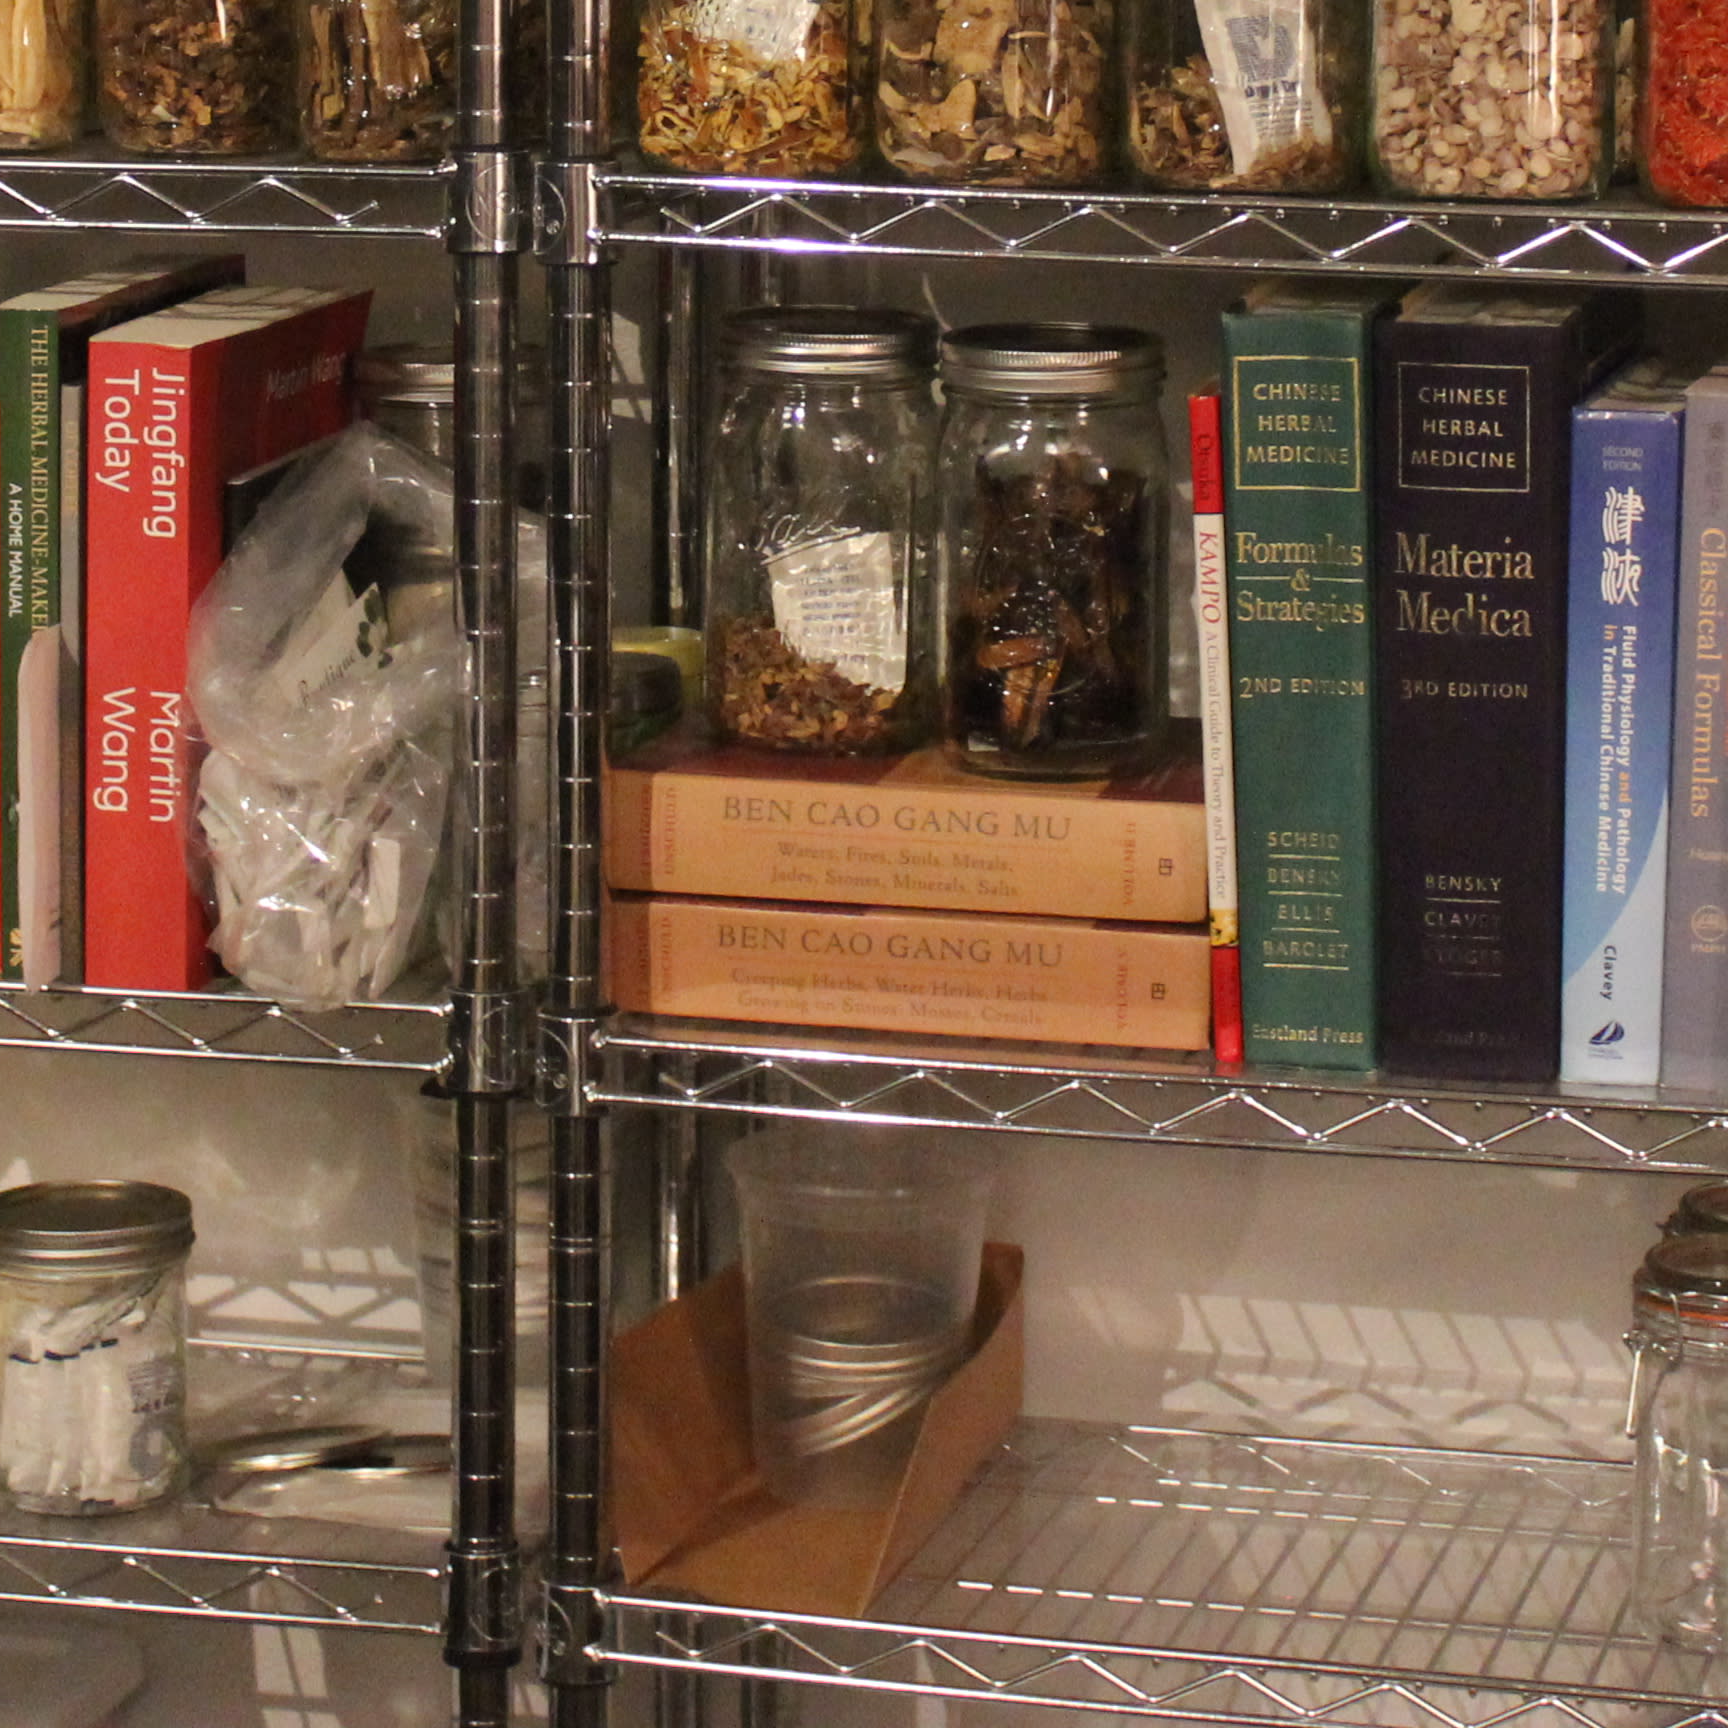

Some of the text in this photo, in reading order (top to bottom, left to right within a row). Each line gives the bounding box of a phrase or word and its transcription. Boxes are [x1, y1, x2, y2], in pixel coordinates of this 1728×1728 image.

[30, 325, 50, 449] THE HERBAL
[1252, 383, 1342, 402] CHINESE
[1418, 386, 1509, 406] CHINESE
[94, 368, 141, 493] Today
[1257, 414, 1337, 433] HERBAL
[1422, 419, 1505, 438] HERBAL
[142, 367, 186, 539] Jingfang
[1246, 445, 1350, 465] MEDICINE
[1410, 450, 1518, 469] MEDICINE
[1602, 446, 1644, 459] SECOND
[8, 483, 23, 618] A HOME MANUAL
[1234, 531, 1364, 567] Formulas
[1395, 531, 1535, 580] Materia
[1198, 531, 1222, 624] KAMPO
[1289, 568, 1312, 592] &
[1235, 590, 1365, 632] Strategies
[1396, 588, 1533, 637] Medica
[1206, 644, 1220, 698] Clinical
[1239, 677, 1365, 699] 2ND EDITION
[1400, 678, 1529, 700] 3RD EDITION
[1690, 527, 1727, 818] Classical Formulas
[1208, 700, 1222, 743] Guide
[93, 687, 137, 812] Wang
[149, 690, 182, 823] Martin
[1596, 645, 1618, 893] Traditional Chinese Medicine
[1612, 624, 1637, 895] Fluid Physiology and Pathology
[1211, 762, 1226, 814] Theory
[723, 795, 1072, 841] BEN CAO GANG MU
[1267, 831, 1340, 850] SCHEID
[1424, 874, 1503, 893] BENSKY
[1277, 904, 1334, 922] ELLIS
[717, 924, 1064, 968] BEN CAO GANG MU
[1599, 944, 1618, 1001] Clavey
[1322, 1025, 1364, 1044] Press
